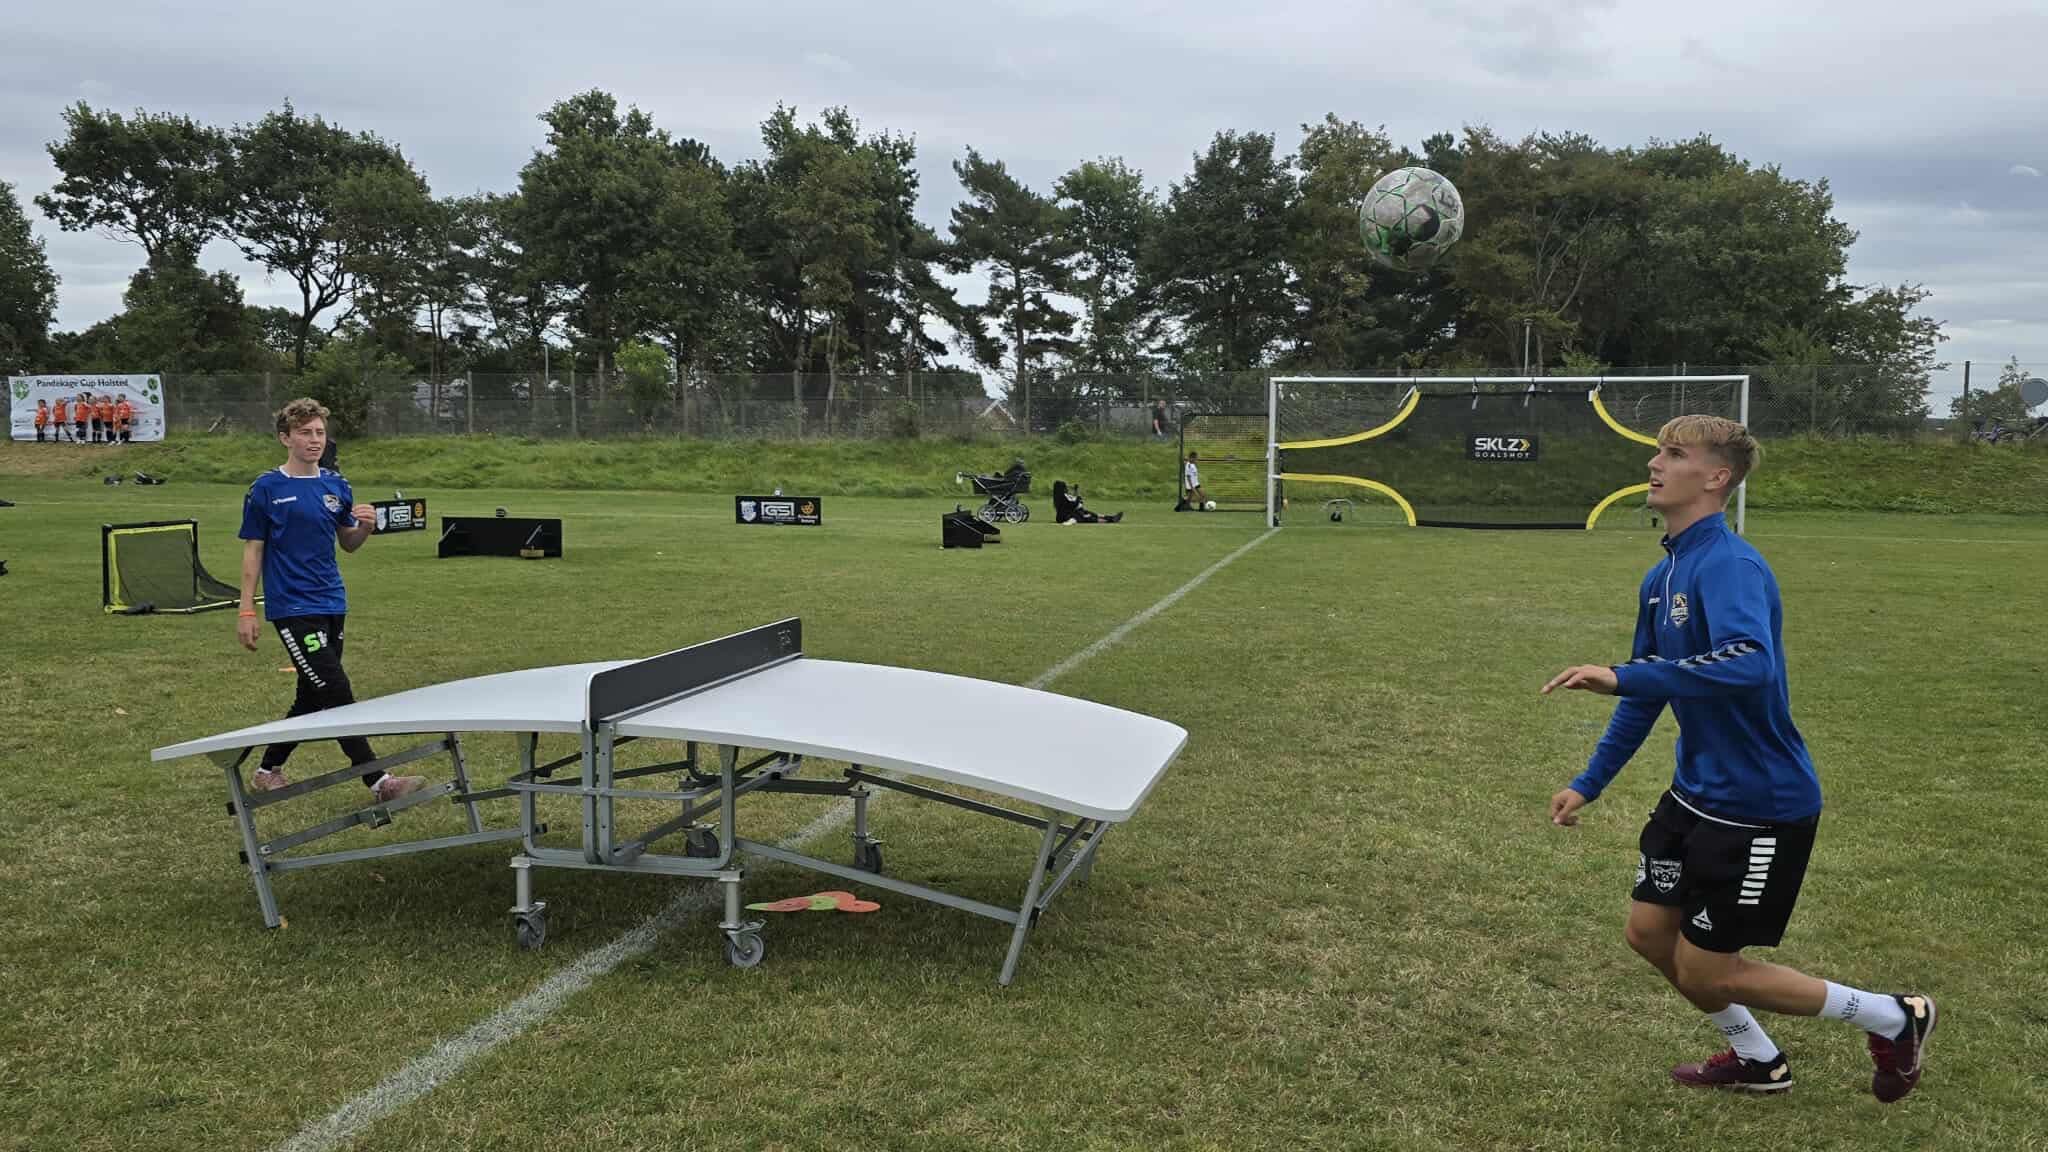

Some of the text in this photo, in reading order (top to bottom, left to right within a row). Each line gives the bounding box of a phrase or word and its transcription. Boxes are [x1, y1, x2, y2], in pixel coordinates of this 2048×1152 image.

[80, 378, 97, 389] Cup
[98, 378, 129, 387] Holsted
[1474, 437, 1520, 451] SKLZ
